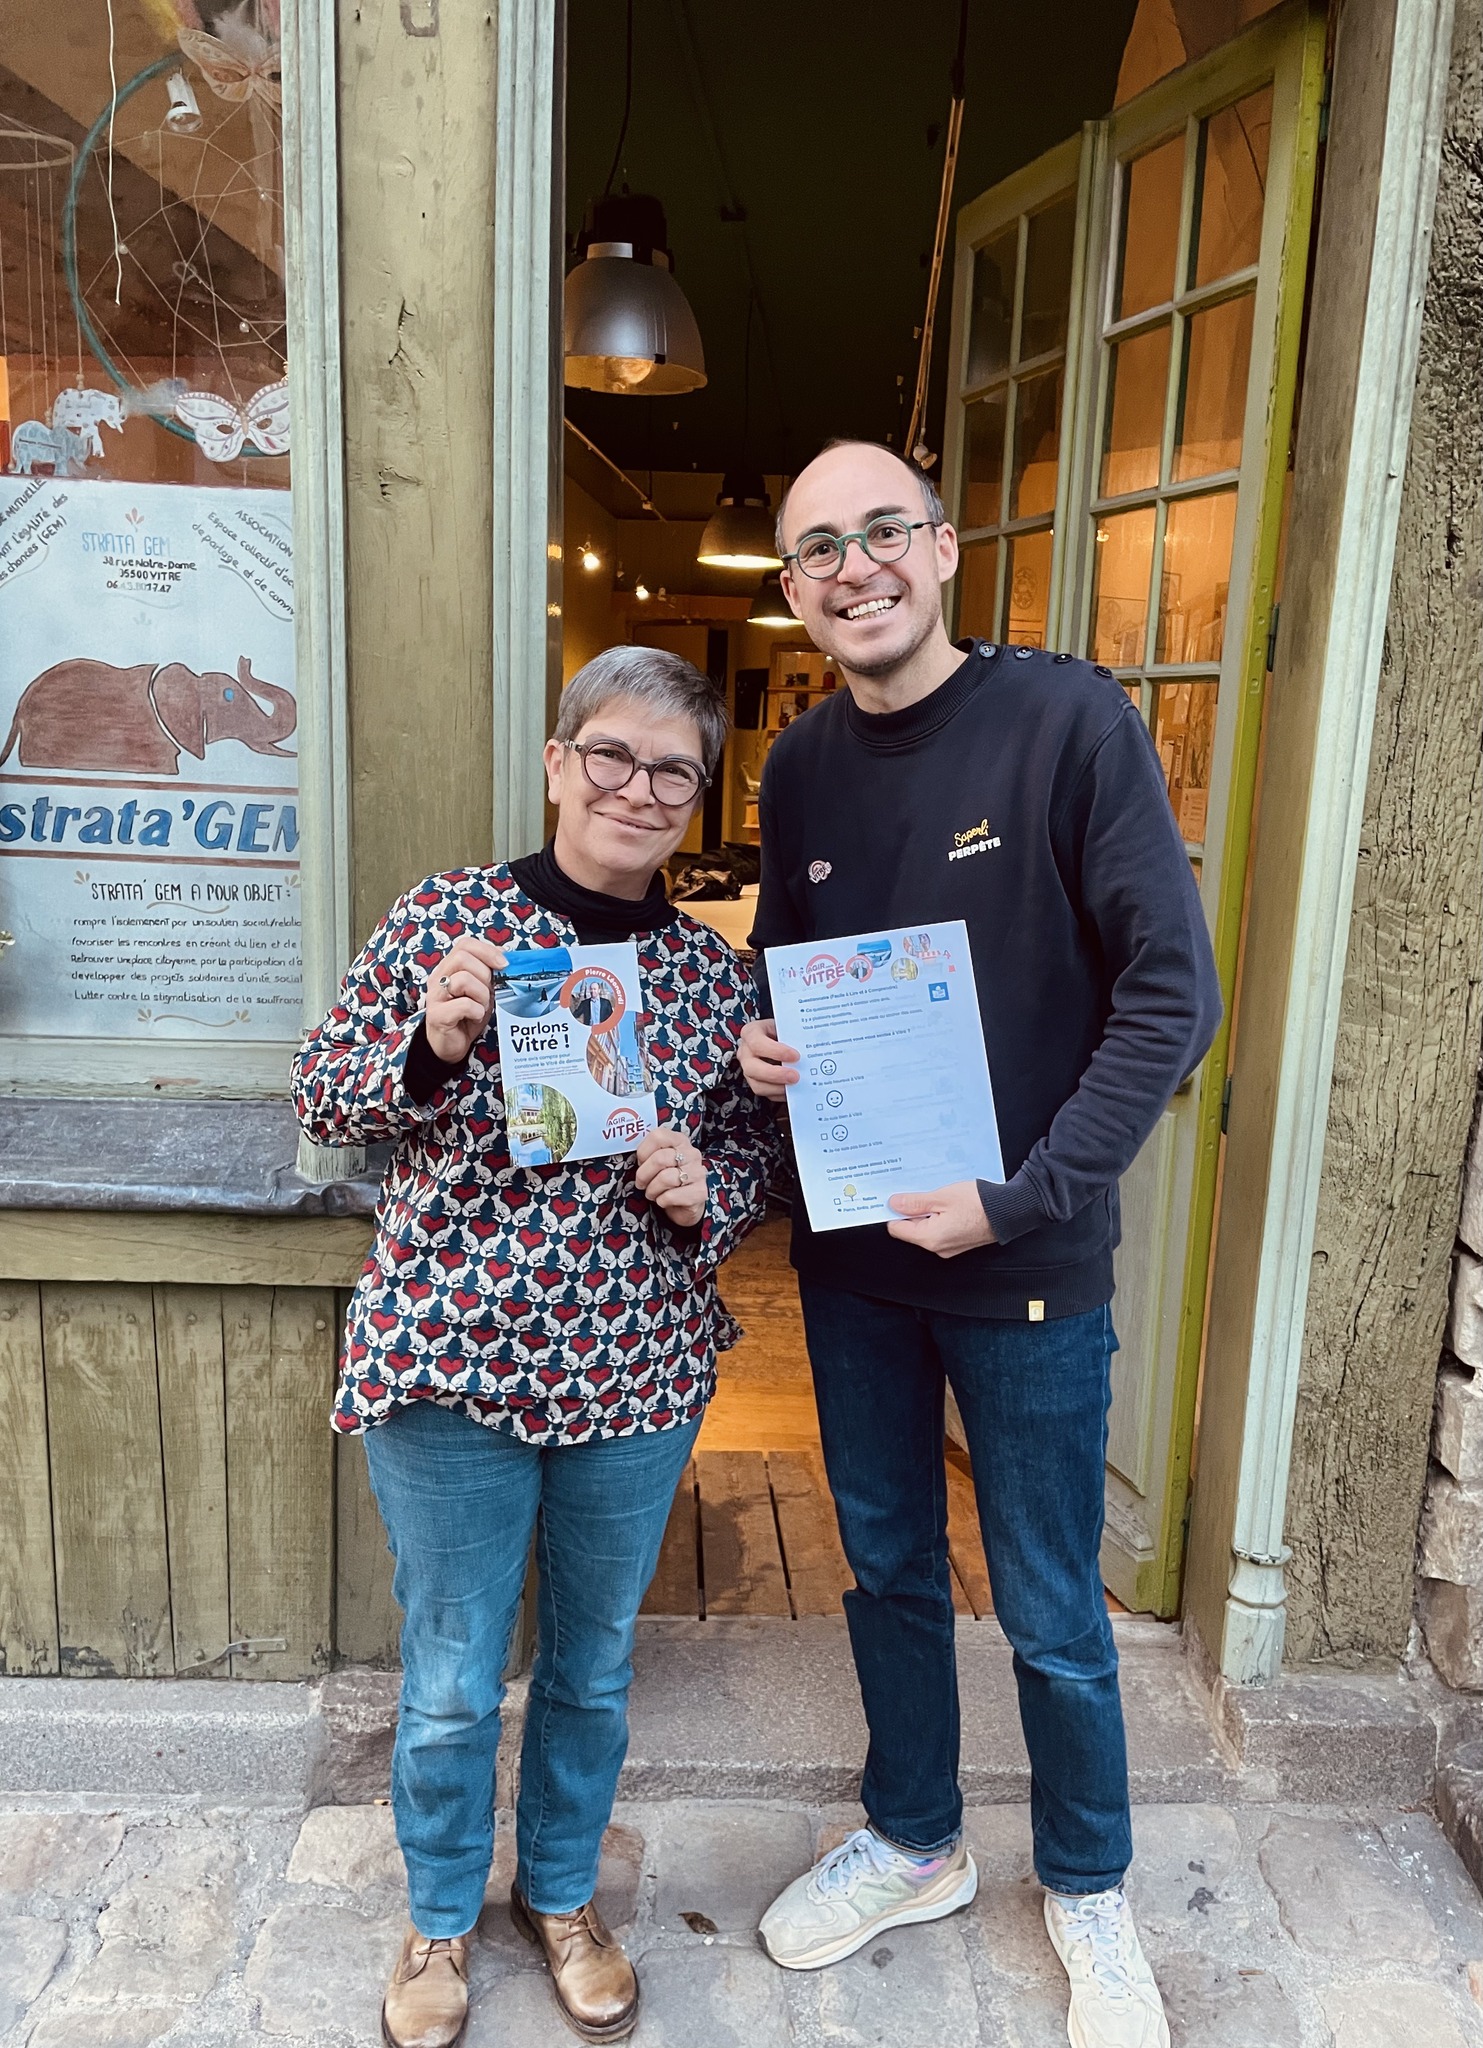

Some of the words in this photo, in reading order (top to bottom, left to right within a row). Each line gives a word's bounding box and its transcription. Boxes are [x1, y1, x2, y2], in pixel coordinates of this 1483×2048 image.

[208, 511, 237, 541] Espace
[240, 540, 277, 568] collectif
[235, 509, 293, 557] ASSOCIATION
[8, 543, 38, 573] chances
[37, 514, 67, 546] (GEM)
[82, 532, 135, 554] STRATA
[192, 523, 205, 536] de
[201, 534, 239, 569] partage
[243, 569, 255, 579] et
[254, 577, 267, 591] de
[155, 883, 182, 901] GEM
[191, 883, 201, 901] A
[207, 883, 239, 901] POUR
[171, 920, 187, 930] par
[117, 938, 130, 947] les
[134, 938, 181, 947] rencontres
[186, 940, 198, 948] en
[200, 936, 231, 948] créant
[234, 937, 247, 948] du
[271, 939, 280, 949] et
[283, 939, 297, 948] de
[71, 952, 114, 963] Retrouver
[200, 958, 216, 969] par
[229, 956, 286, 970] participation
[130, 972, 147, 981] des
[188, 972, 235, 983] solidaires
[802, 962, 846, 987] VITRÉ
[74, 989, 104, 1000] Lutter
[107, 991, 138, 1001] contre
[140, 991, 150, 1001] la
[153, 990, 221, 1004] stigmatisation
[226, 994, 238, 1003] de
[242, 995, 252, 1003] la
[510, 1021, 569, 1037] Parlons
[511, 1034, 559, 1053] Vitré
[608, 1116, 626, 1126] AGIR
